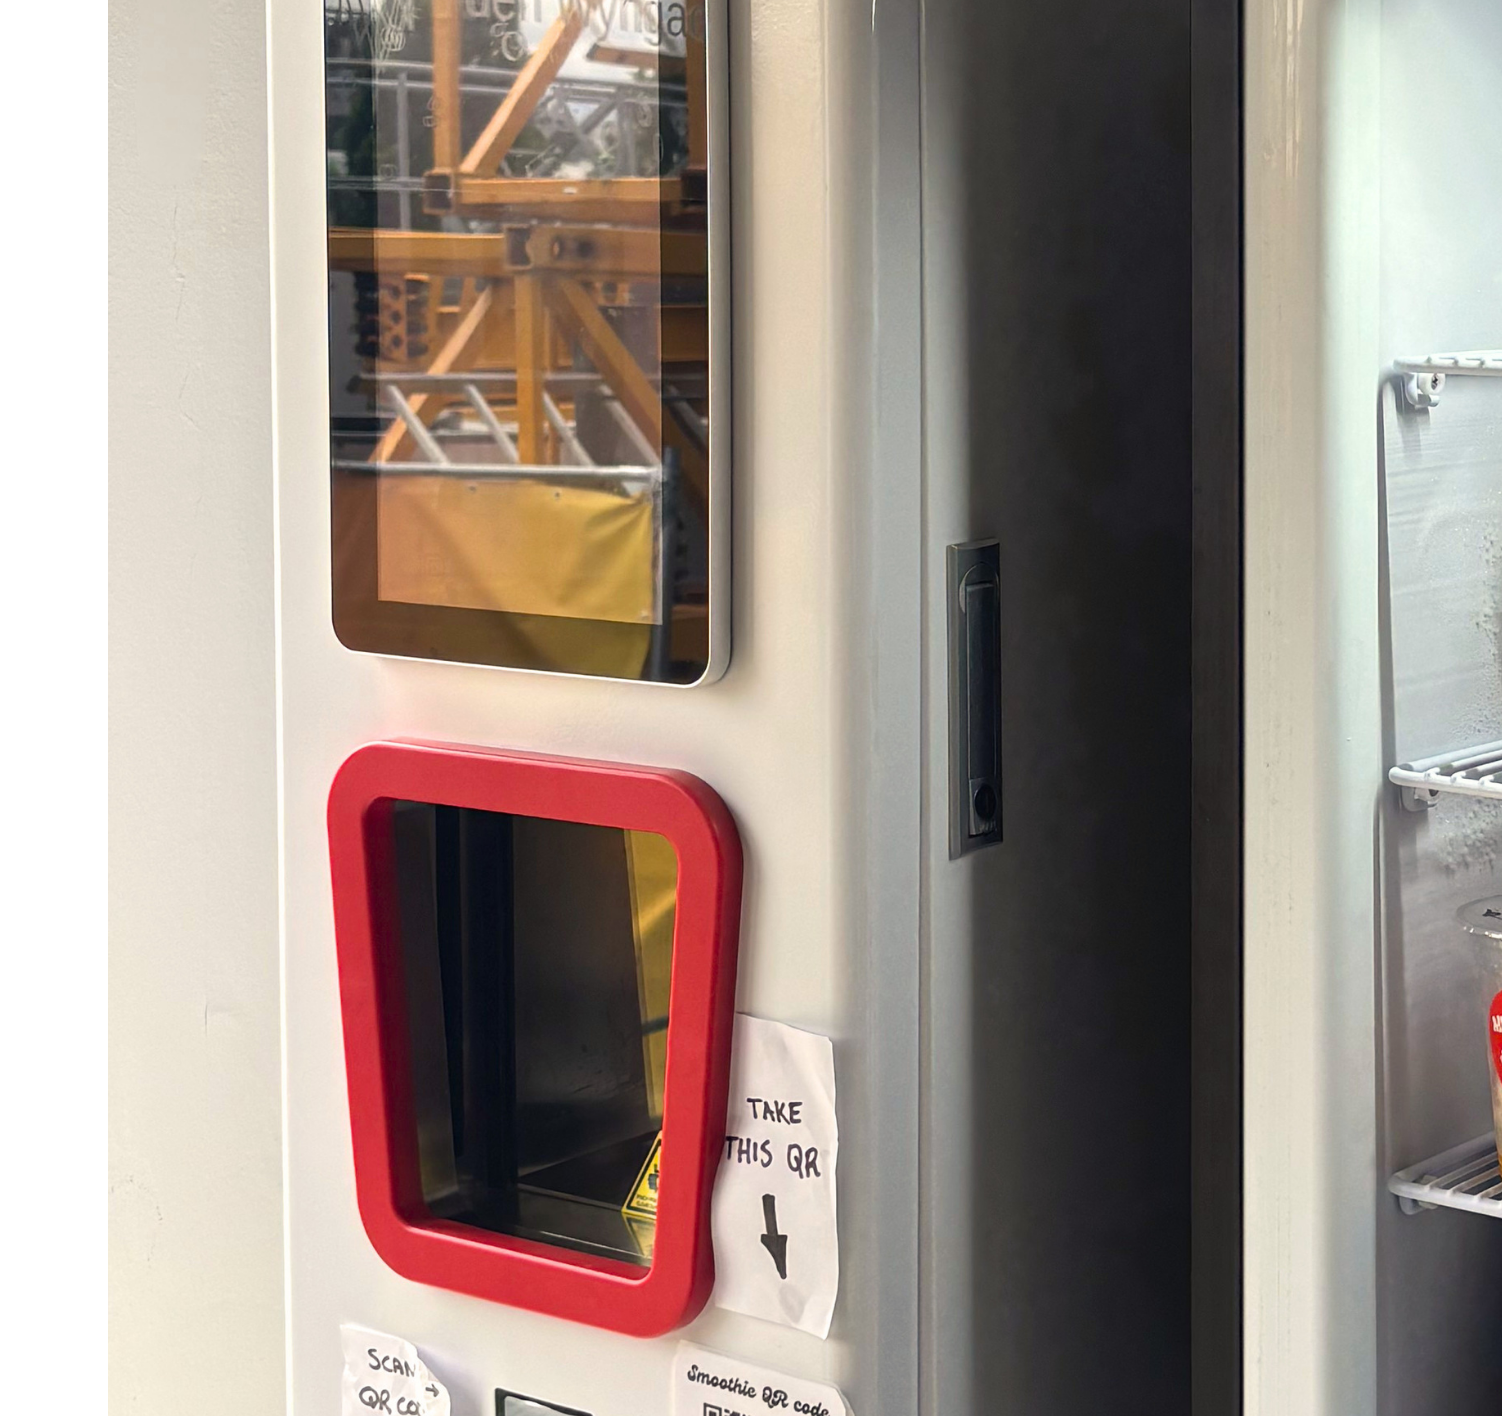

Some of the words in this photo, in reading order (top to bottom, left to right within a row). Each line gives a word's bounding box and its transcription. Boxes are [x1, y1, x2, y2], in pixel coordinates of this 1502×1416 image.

[746, 1098, 803, 1125] TAKE
[725, 1136, 773, 1168] THIS
[787, 1144, 821, 1179] QR
[367, 1348, 416, 1377] SCAN
[359, 1385, 392, 1415] QR
[687, 1364, 757, 1398] Smoothie
[762, 1386, 789, 1409] QR
